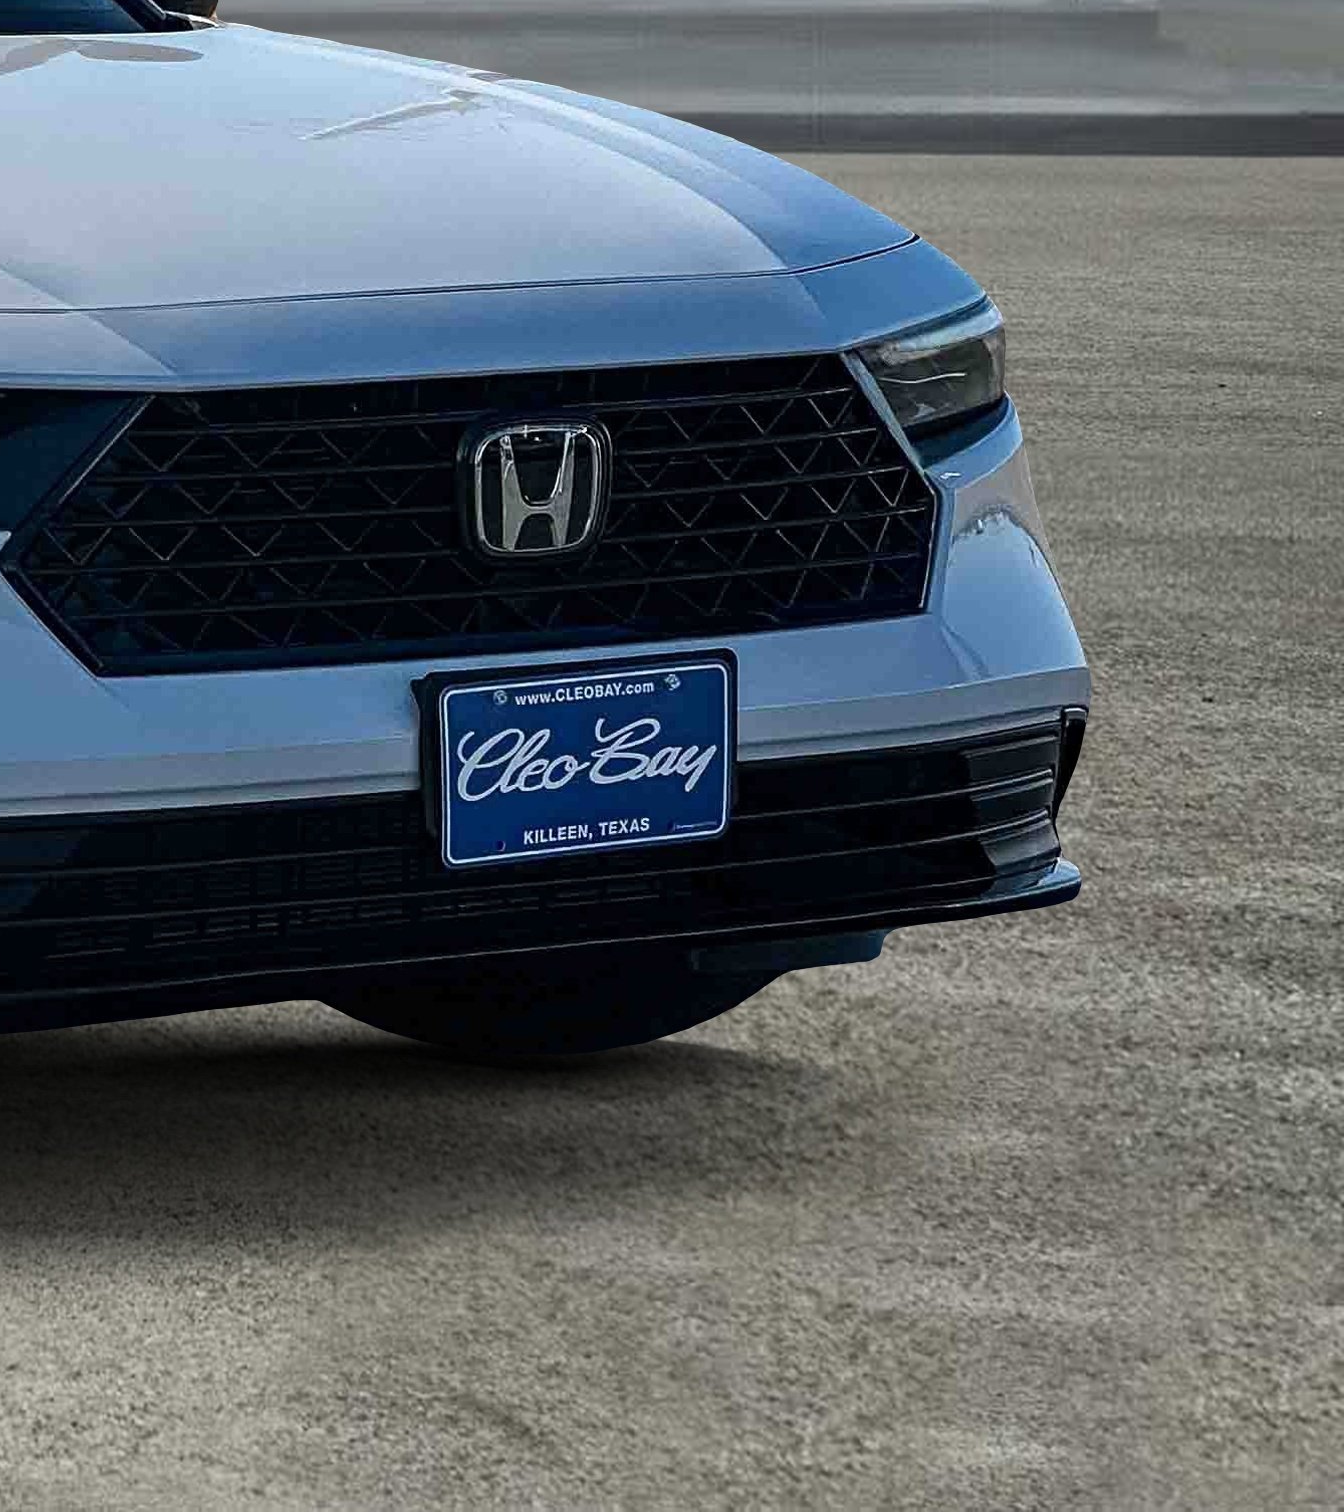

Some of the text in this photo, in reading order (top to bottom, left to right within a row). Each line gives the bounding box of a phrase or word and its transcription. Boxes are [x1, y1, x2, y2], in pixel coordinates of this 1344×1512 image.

[514, 681, 654, 706] www.CLEOBAY.com
[456, 717, 718, 802] Cleo Bay
[522, 823, 594, 845] KILLEEN,
[598, 816, 651, 837] TEXAS
